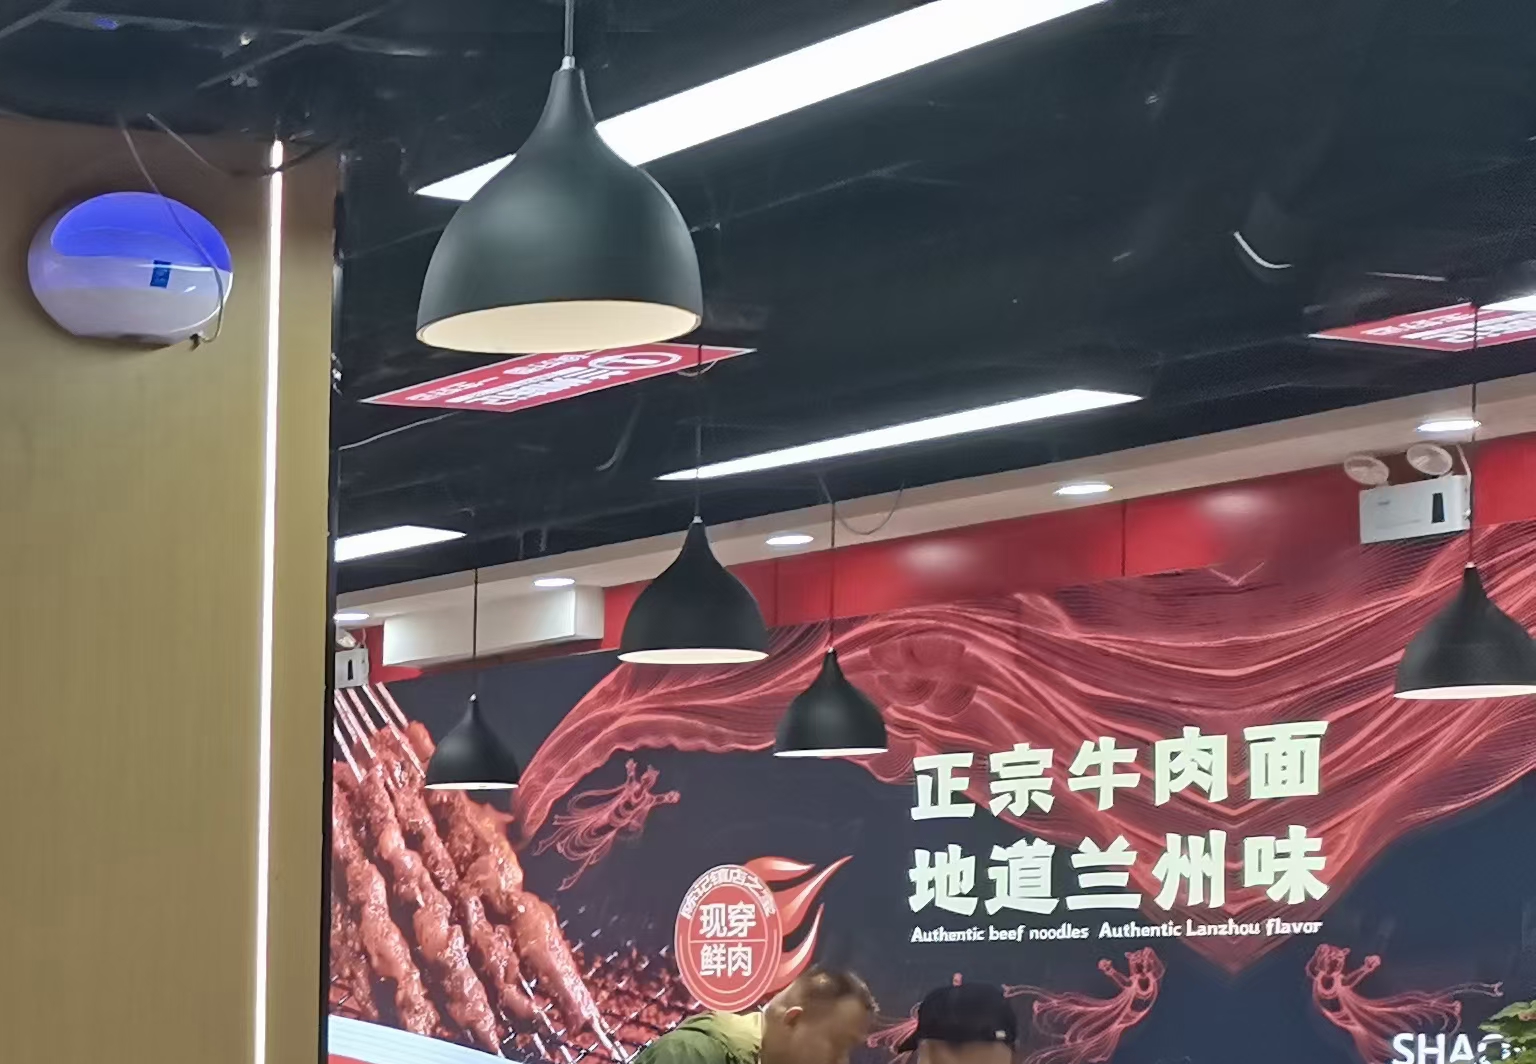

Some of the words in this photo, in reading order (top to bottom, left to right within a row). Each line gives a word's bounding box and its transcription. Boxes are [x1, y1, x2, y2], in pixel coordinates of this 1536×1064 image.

[910, 720, 1330, 821] 正宗牛肉面
[908, 825, 1330, 917] 地道兰州味
[698, 900, 757, 938] 现穿
[910, 925, 985, 943] Authentic
[989, 924, 1027, 942] beef
[1029, 922, 1090, 940] noodles
[1098, 919, 1182, 939] Authentic
[1186, 917, 1261, 938] Lanzhou
[1266, 916, 1324, 936] flavor
[699, 942, 753, 977] 鲜肉
